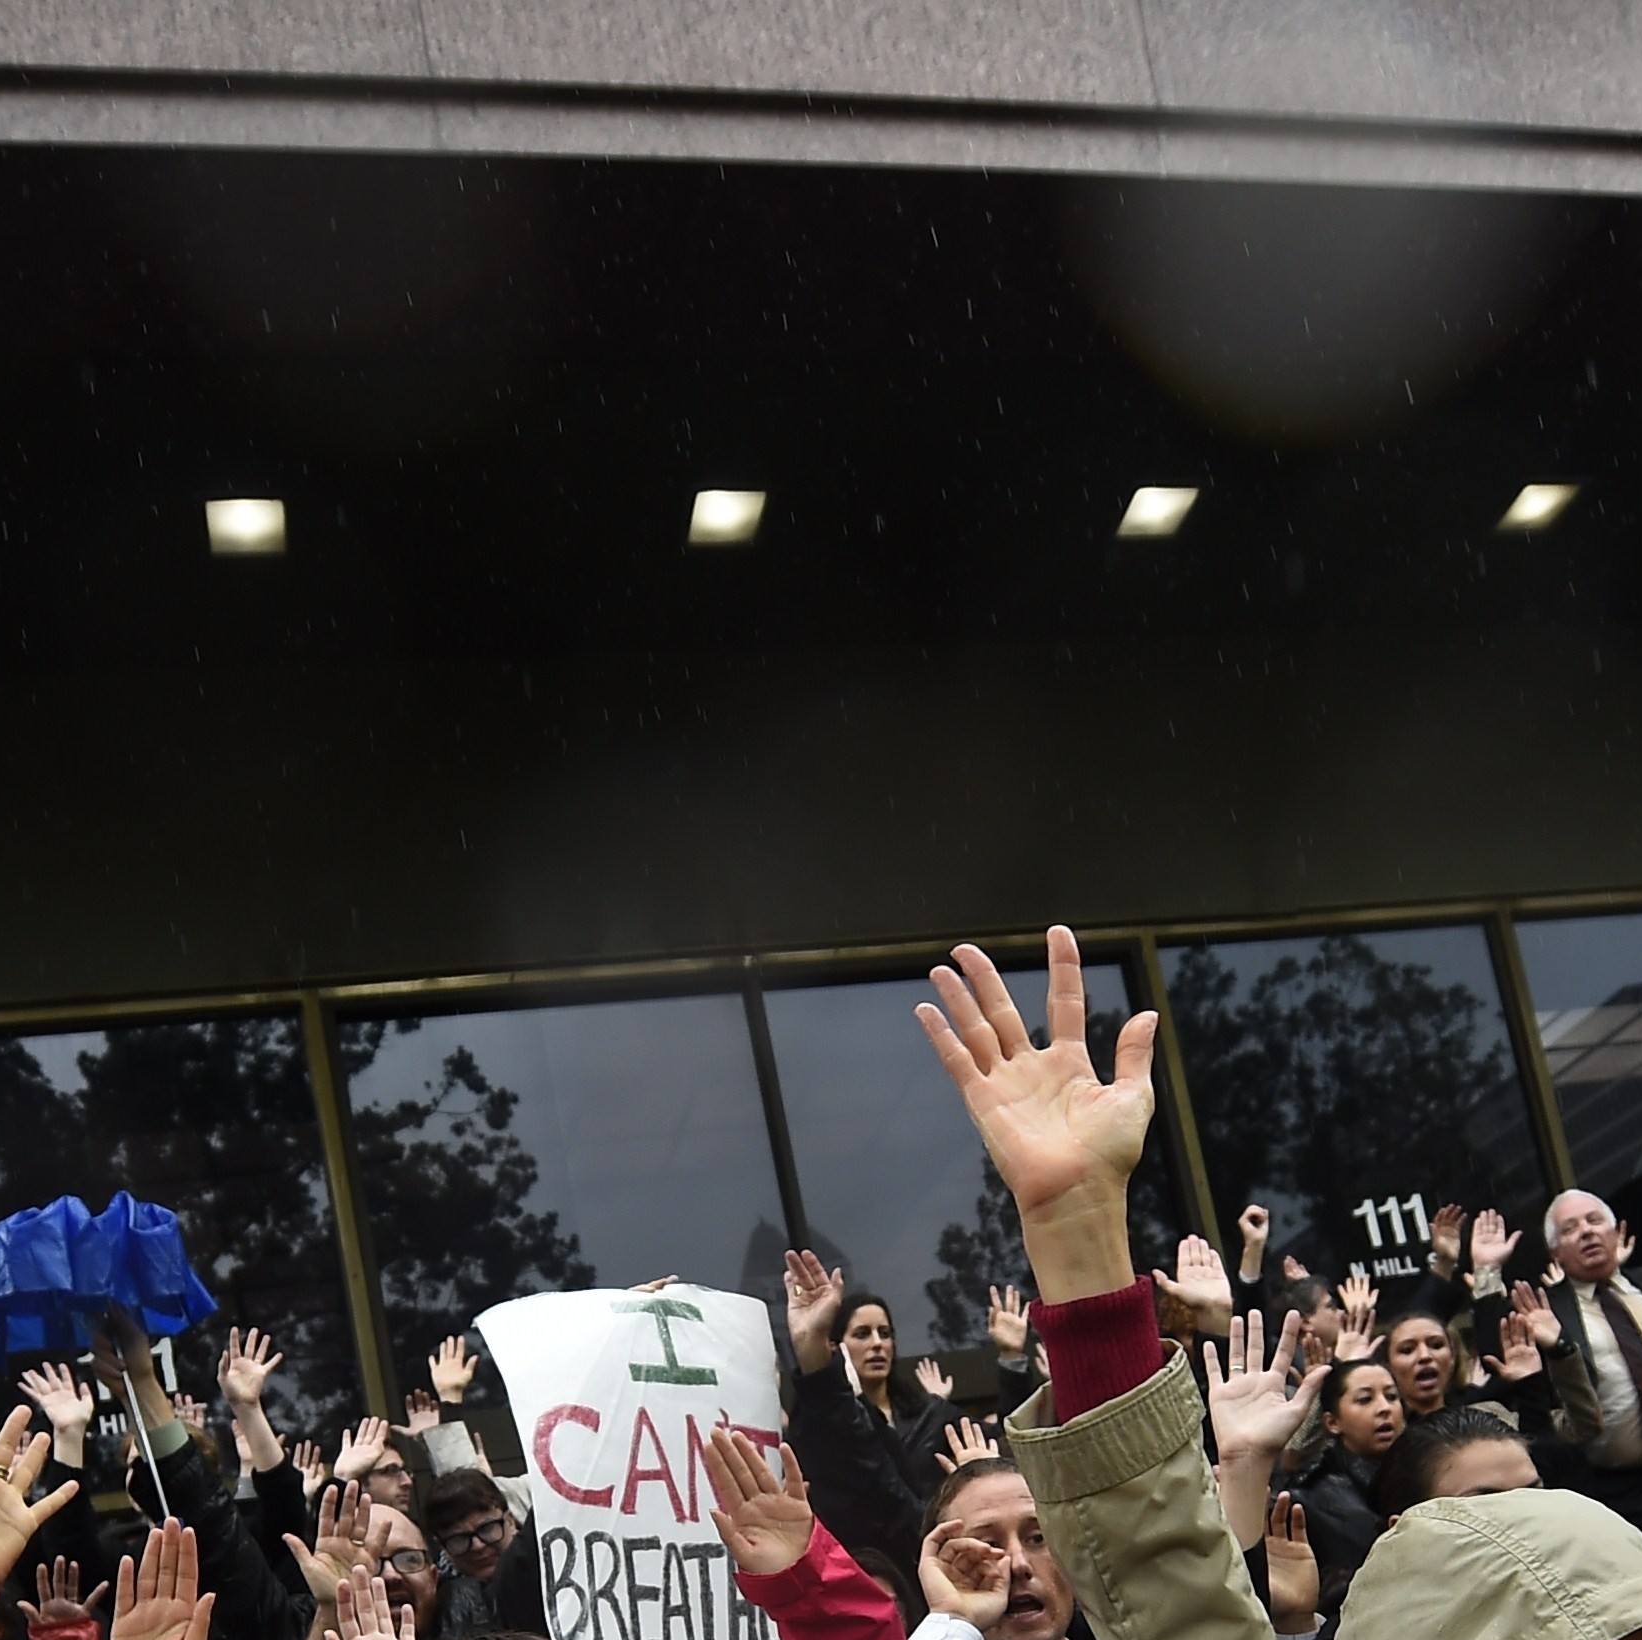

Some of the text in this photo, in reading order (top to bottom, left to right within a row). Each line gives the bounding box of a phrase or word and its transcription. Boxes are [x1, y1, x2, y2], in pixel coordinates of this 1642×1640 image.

[1353, 1193, 1431, 1247] 111
[1373, 1255, 1421, 1278] HILL
[610, 1297, 719, 1387] I
